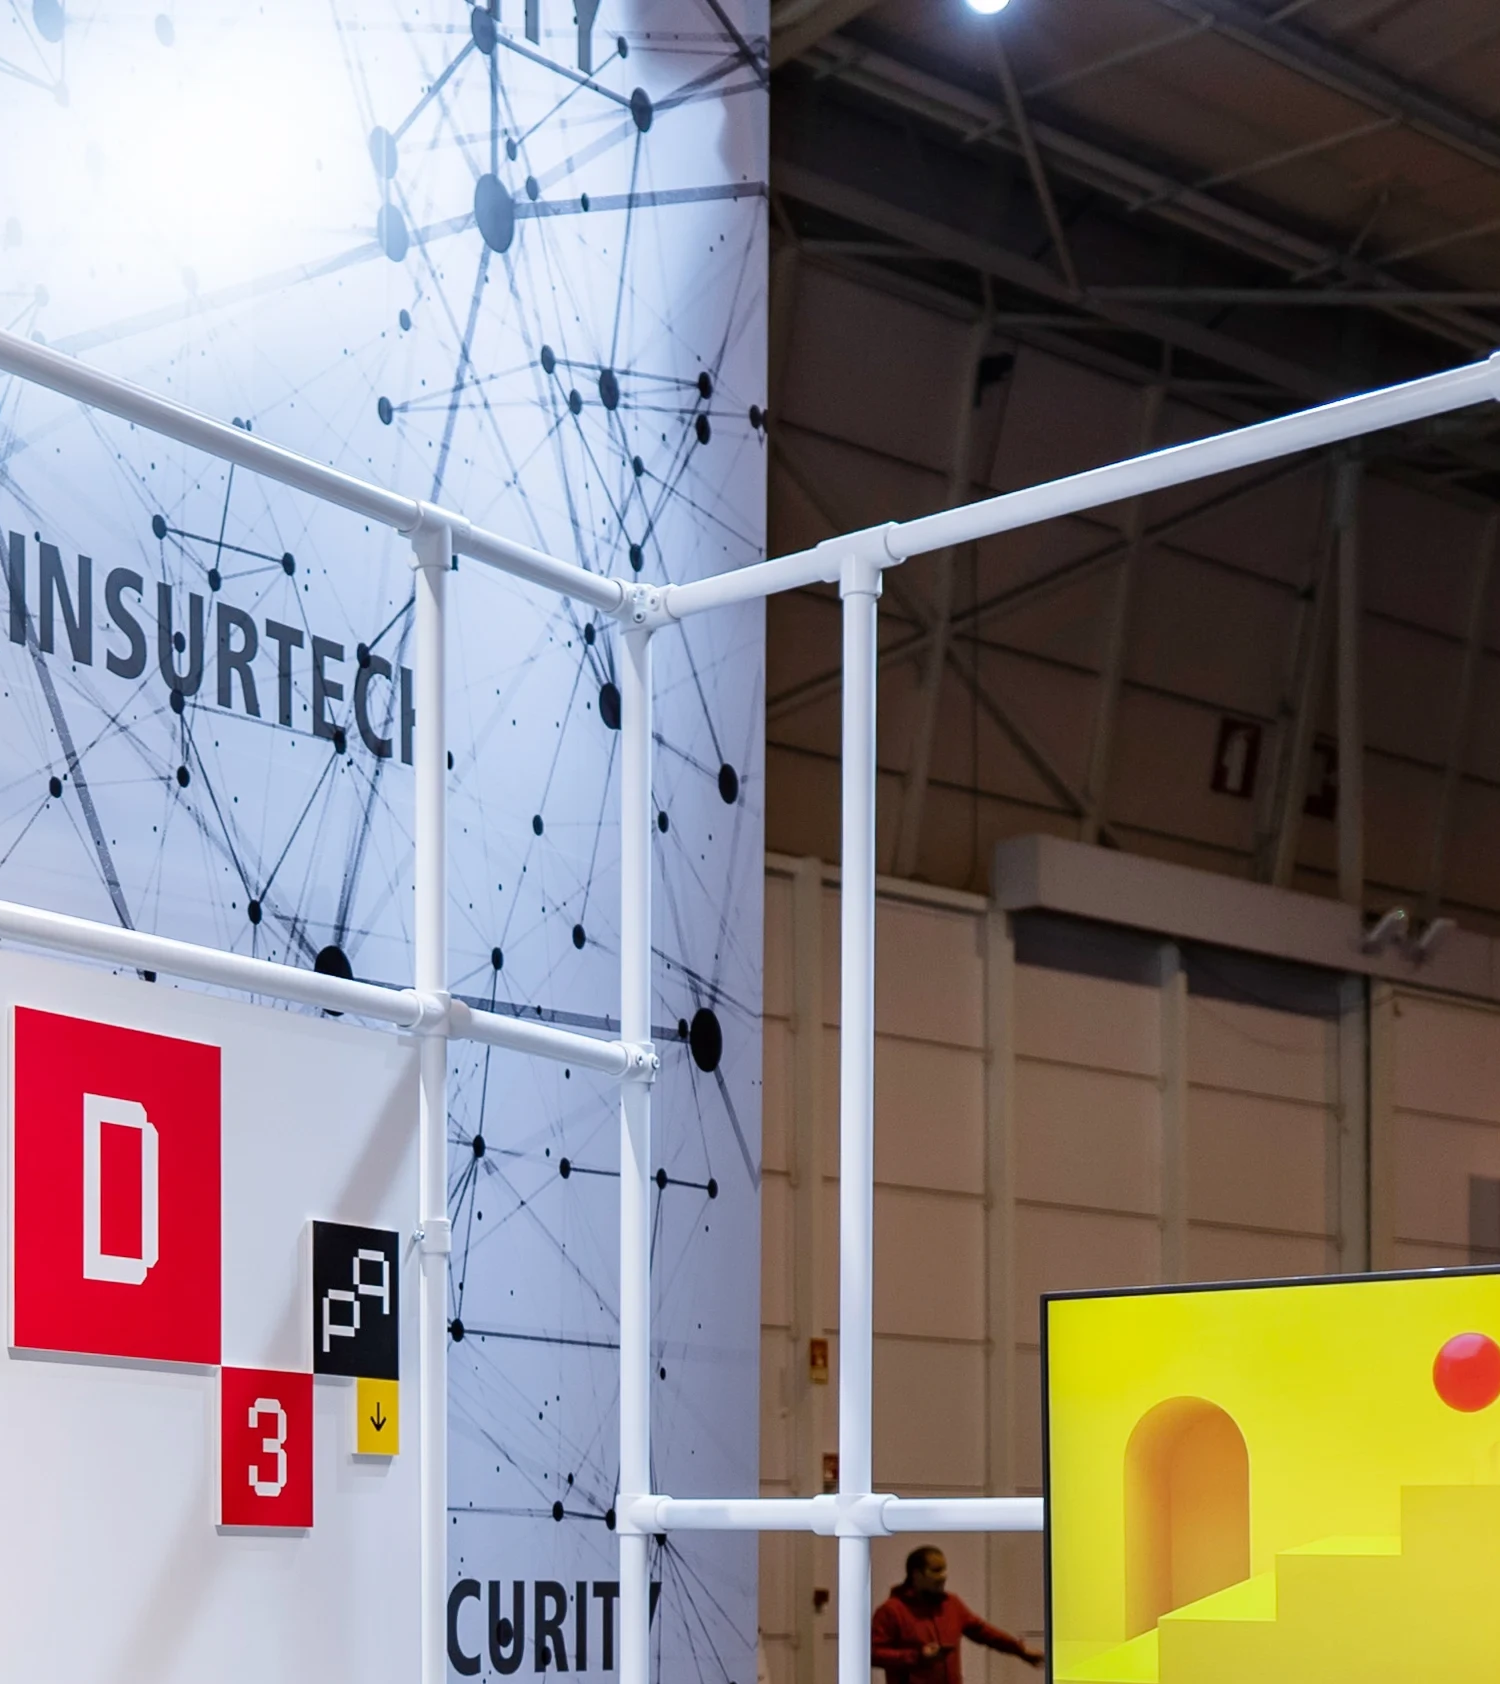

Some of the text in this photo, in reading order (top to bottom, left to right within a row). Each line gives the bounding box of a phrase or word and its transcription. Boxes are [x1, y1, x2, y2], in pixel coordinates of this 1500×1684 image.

[83, 1092, 159, 1286] D
[322, 1248, 390, 1353] pq
[248, 1397, 288, 1497] 3
